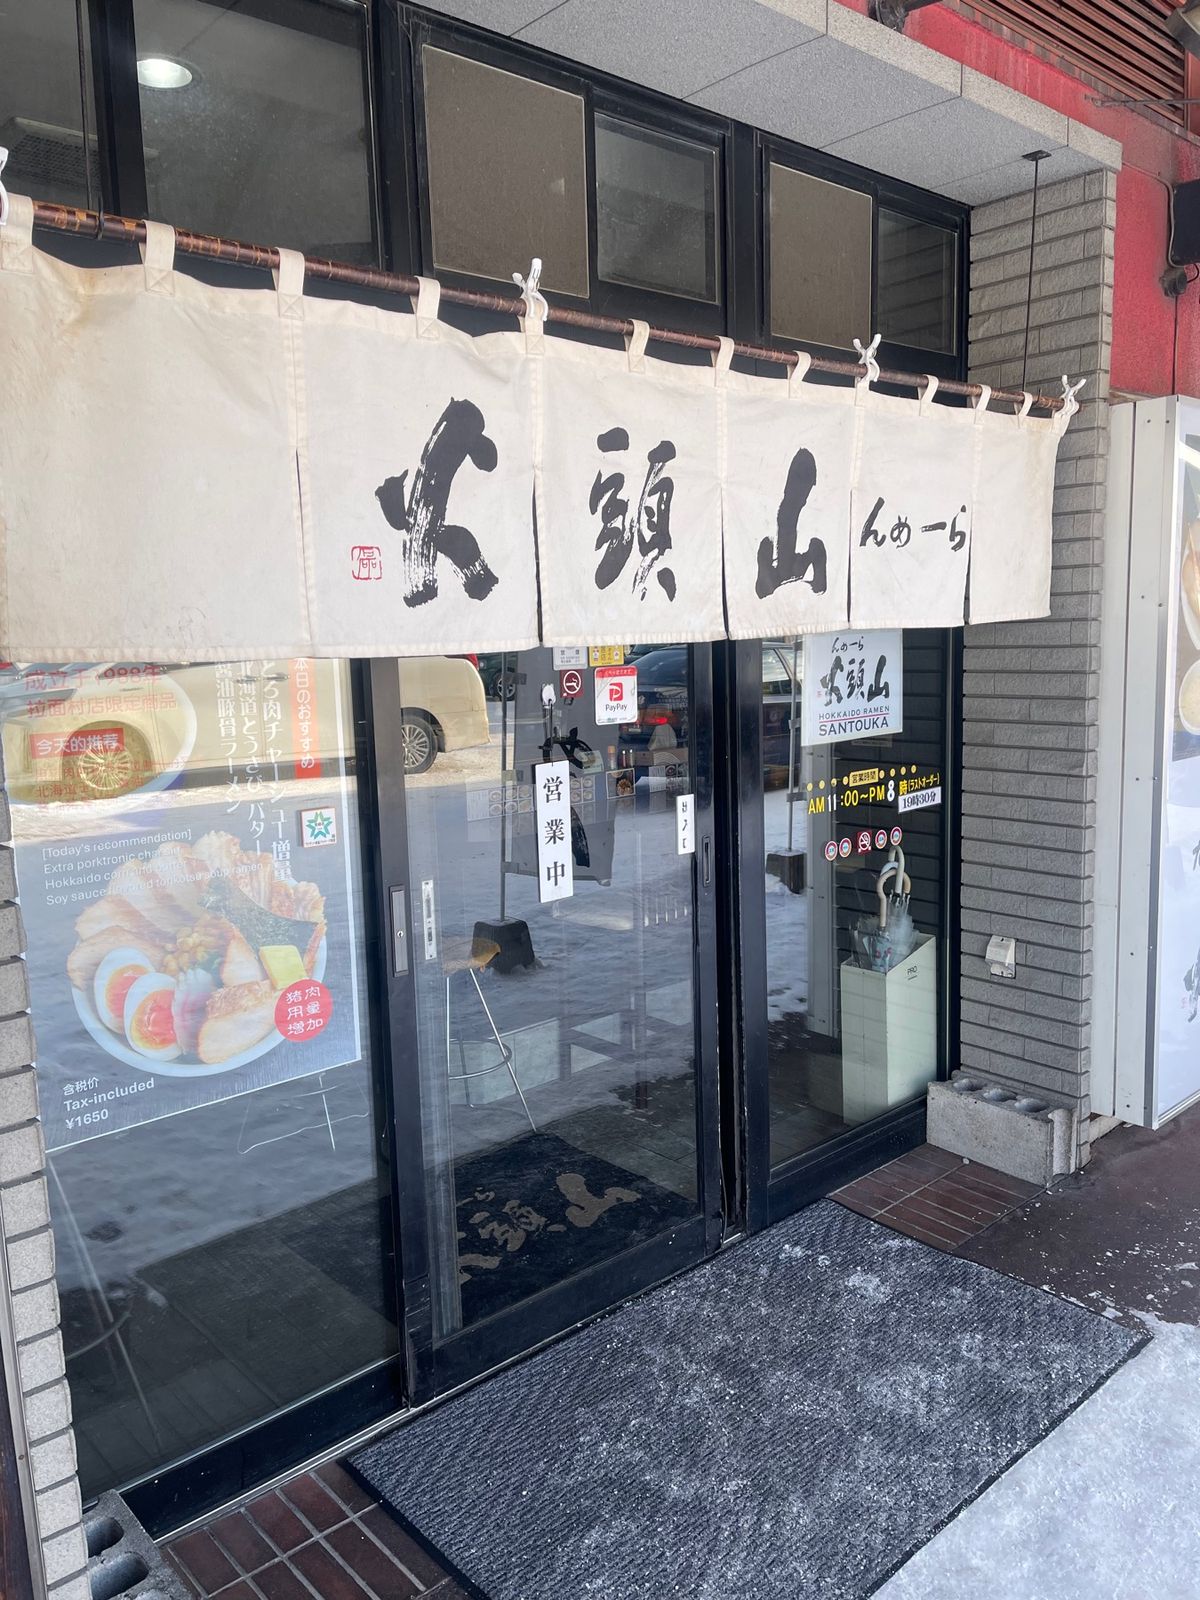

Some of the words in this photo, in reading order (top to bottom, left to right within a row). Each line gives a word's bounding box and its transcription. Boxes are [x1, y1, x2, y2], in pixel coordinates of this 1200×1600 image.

[294, 658, 315, 770] 本日のおすすめ
[605, 703, 627, 712] PayPay
[818, 709, 861, 721] HOKKAIDO
[863, 705, 890, 715] RAMEN
[818, 716, 889, 737] SANTOUKA
[543, 776, 565, 887] 営業中
[42, 843, 90, 861] [Today's
[93, 829, 192, 851] recommendation]
[44, 862, 74, 874] Extra
[77, 853, 136, 871] porktronic
[45, 873, 101, 889] Hokkaido
[46, 894, 68, 906] Soy
[71, 888, 106, 902] sauce
[63, 1077, 99, 1096] 含税价
[63, 1077, 155, 1112] Tax-included
[65, 1108, 109, 1130] ¥1650
